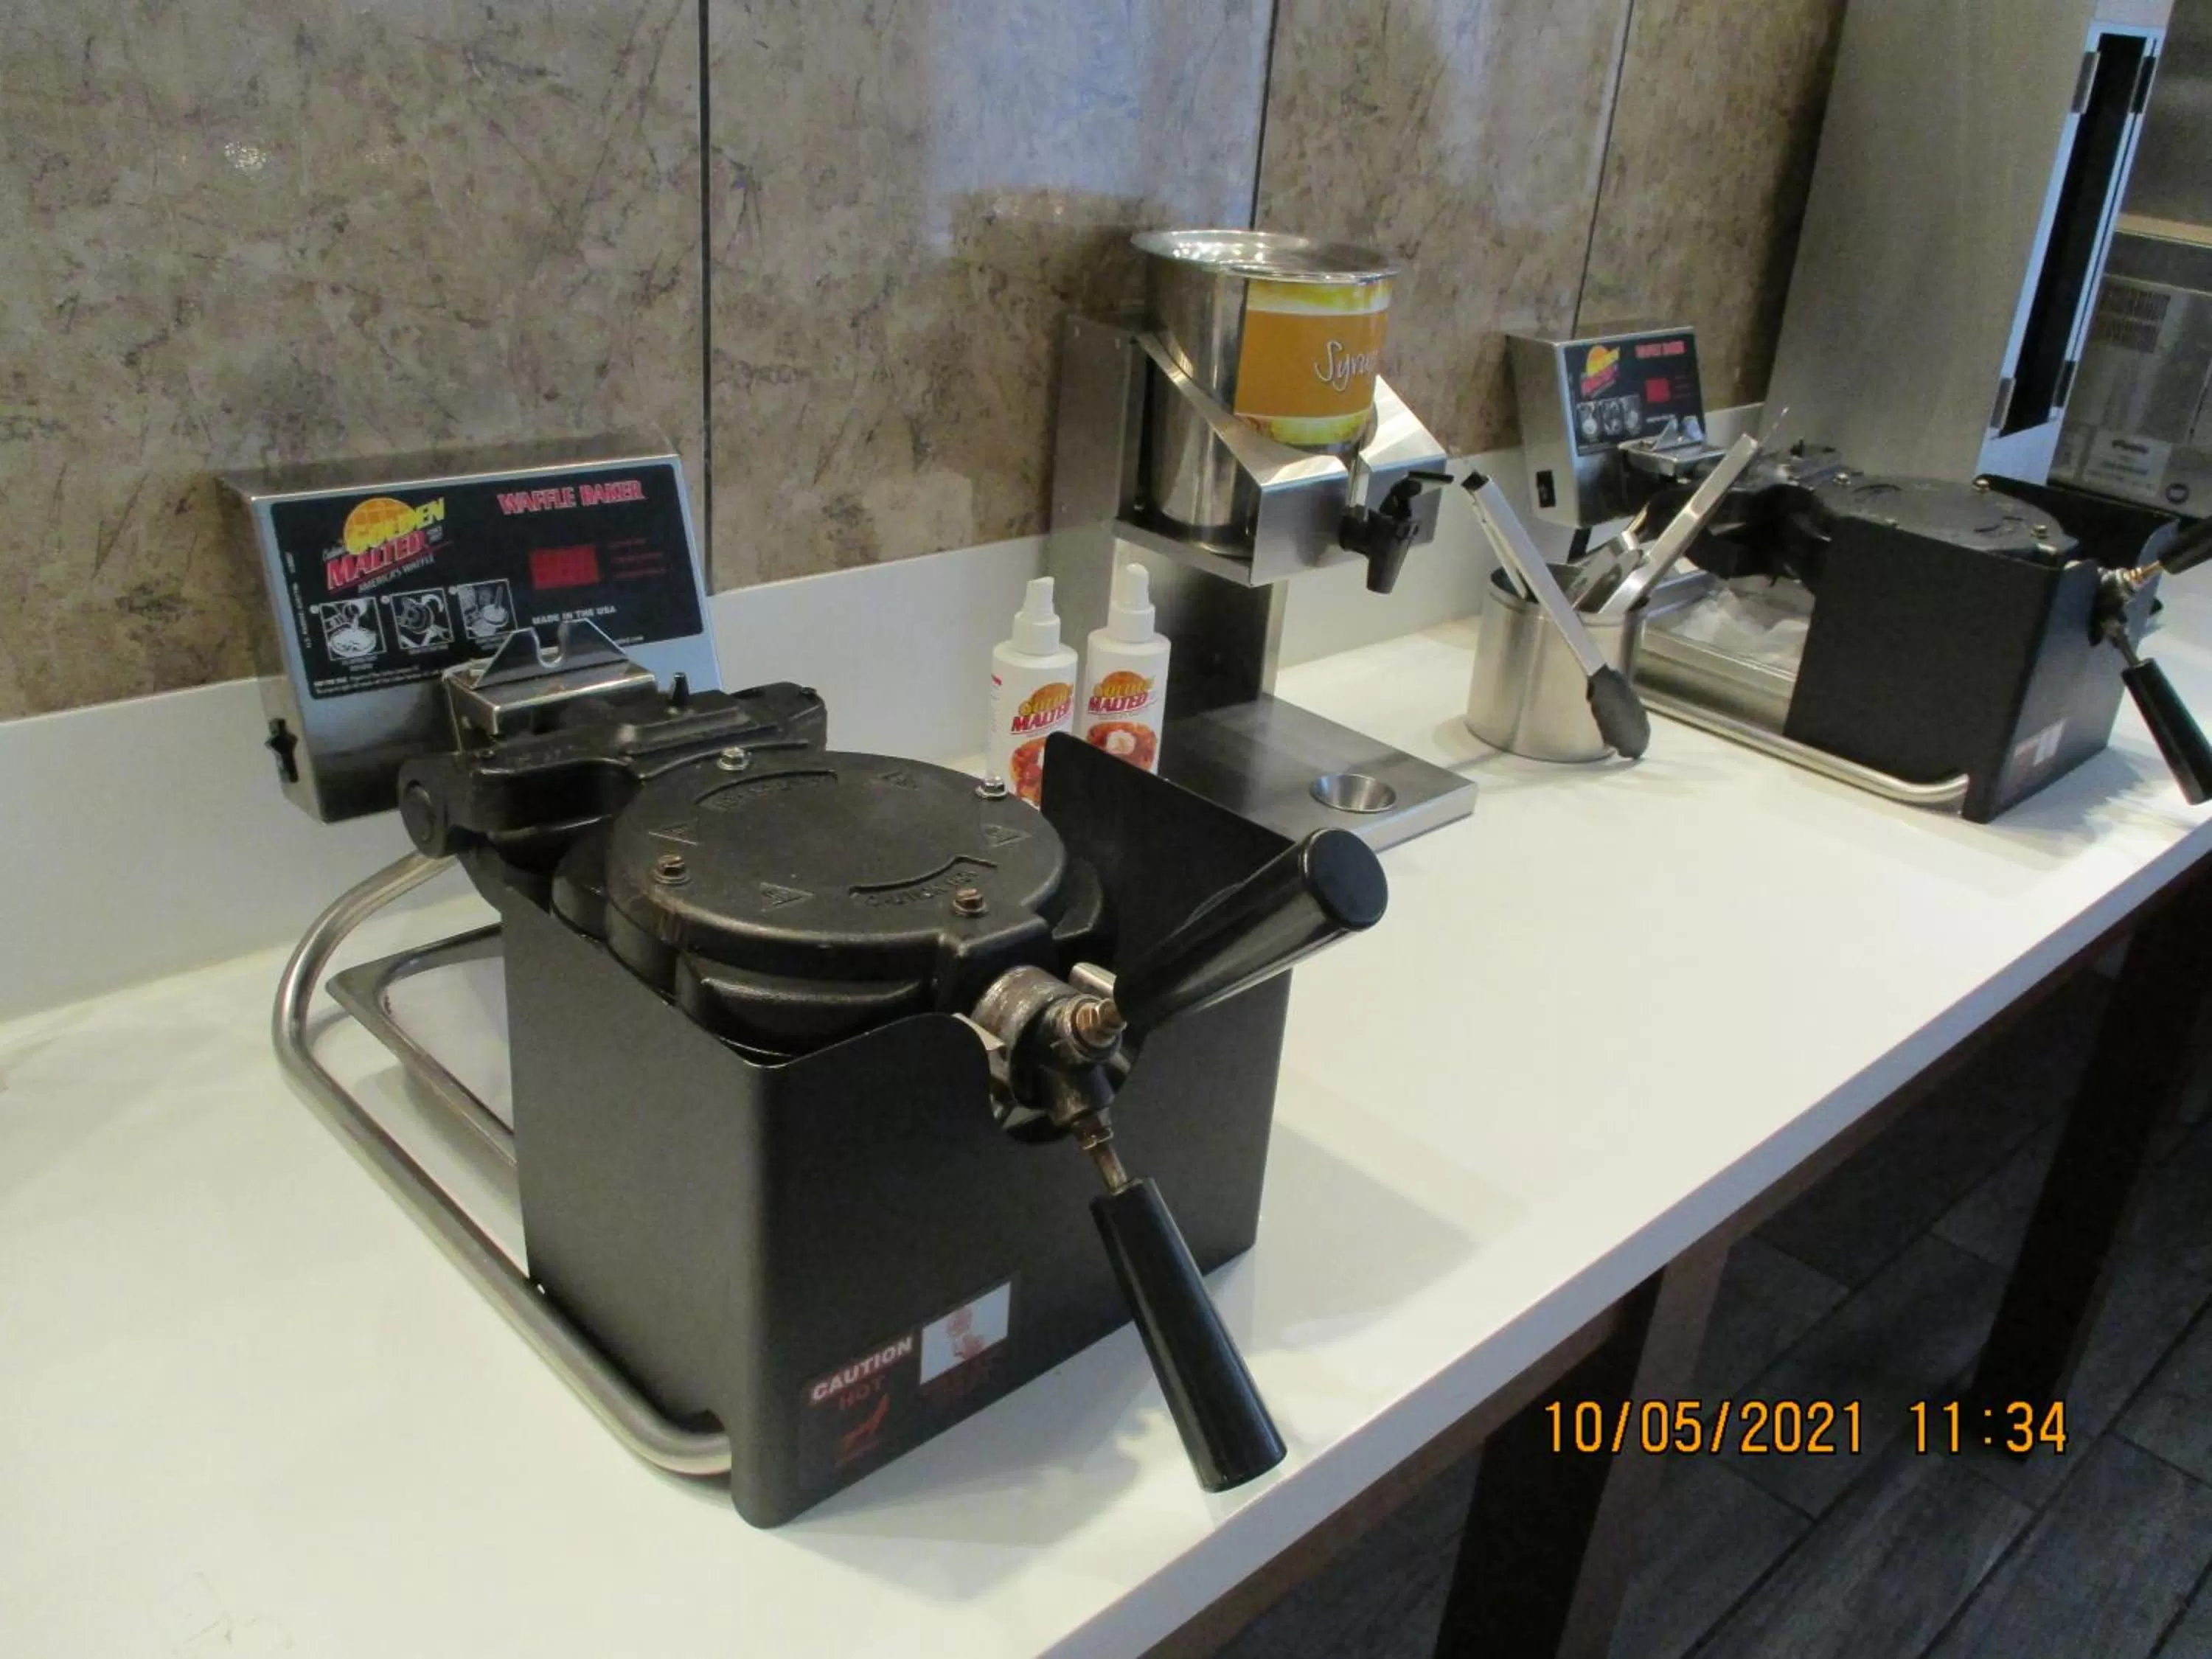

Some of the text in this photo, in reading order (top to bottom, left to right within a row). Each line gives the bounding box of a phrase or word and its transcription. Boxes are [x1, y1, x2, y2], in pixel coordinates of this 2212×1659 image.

[1314, 341, 1378, 392] Syr
[496, 486, 577, 515] WAFFLE
[327, 529, 426, 591] MALTED
[596, 605, 618, 616] USA
[812, 1336, 913, 1402] CAUTION
